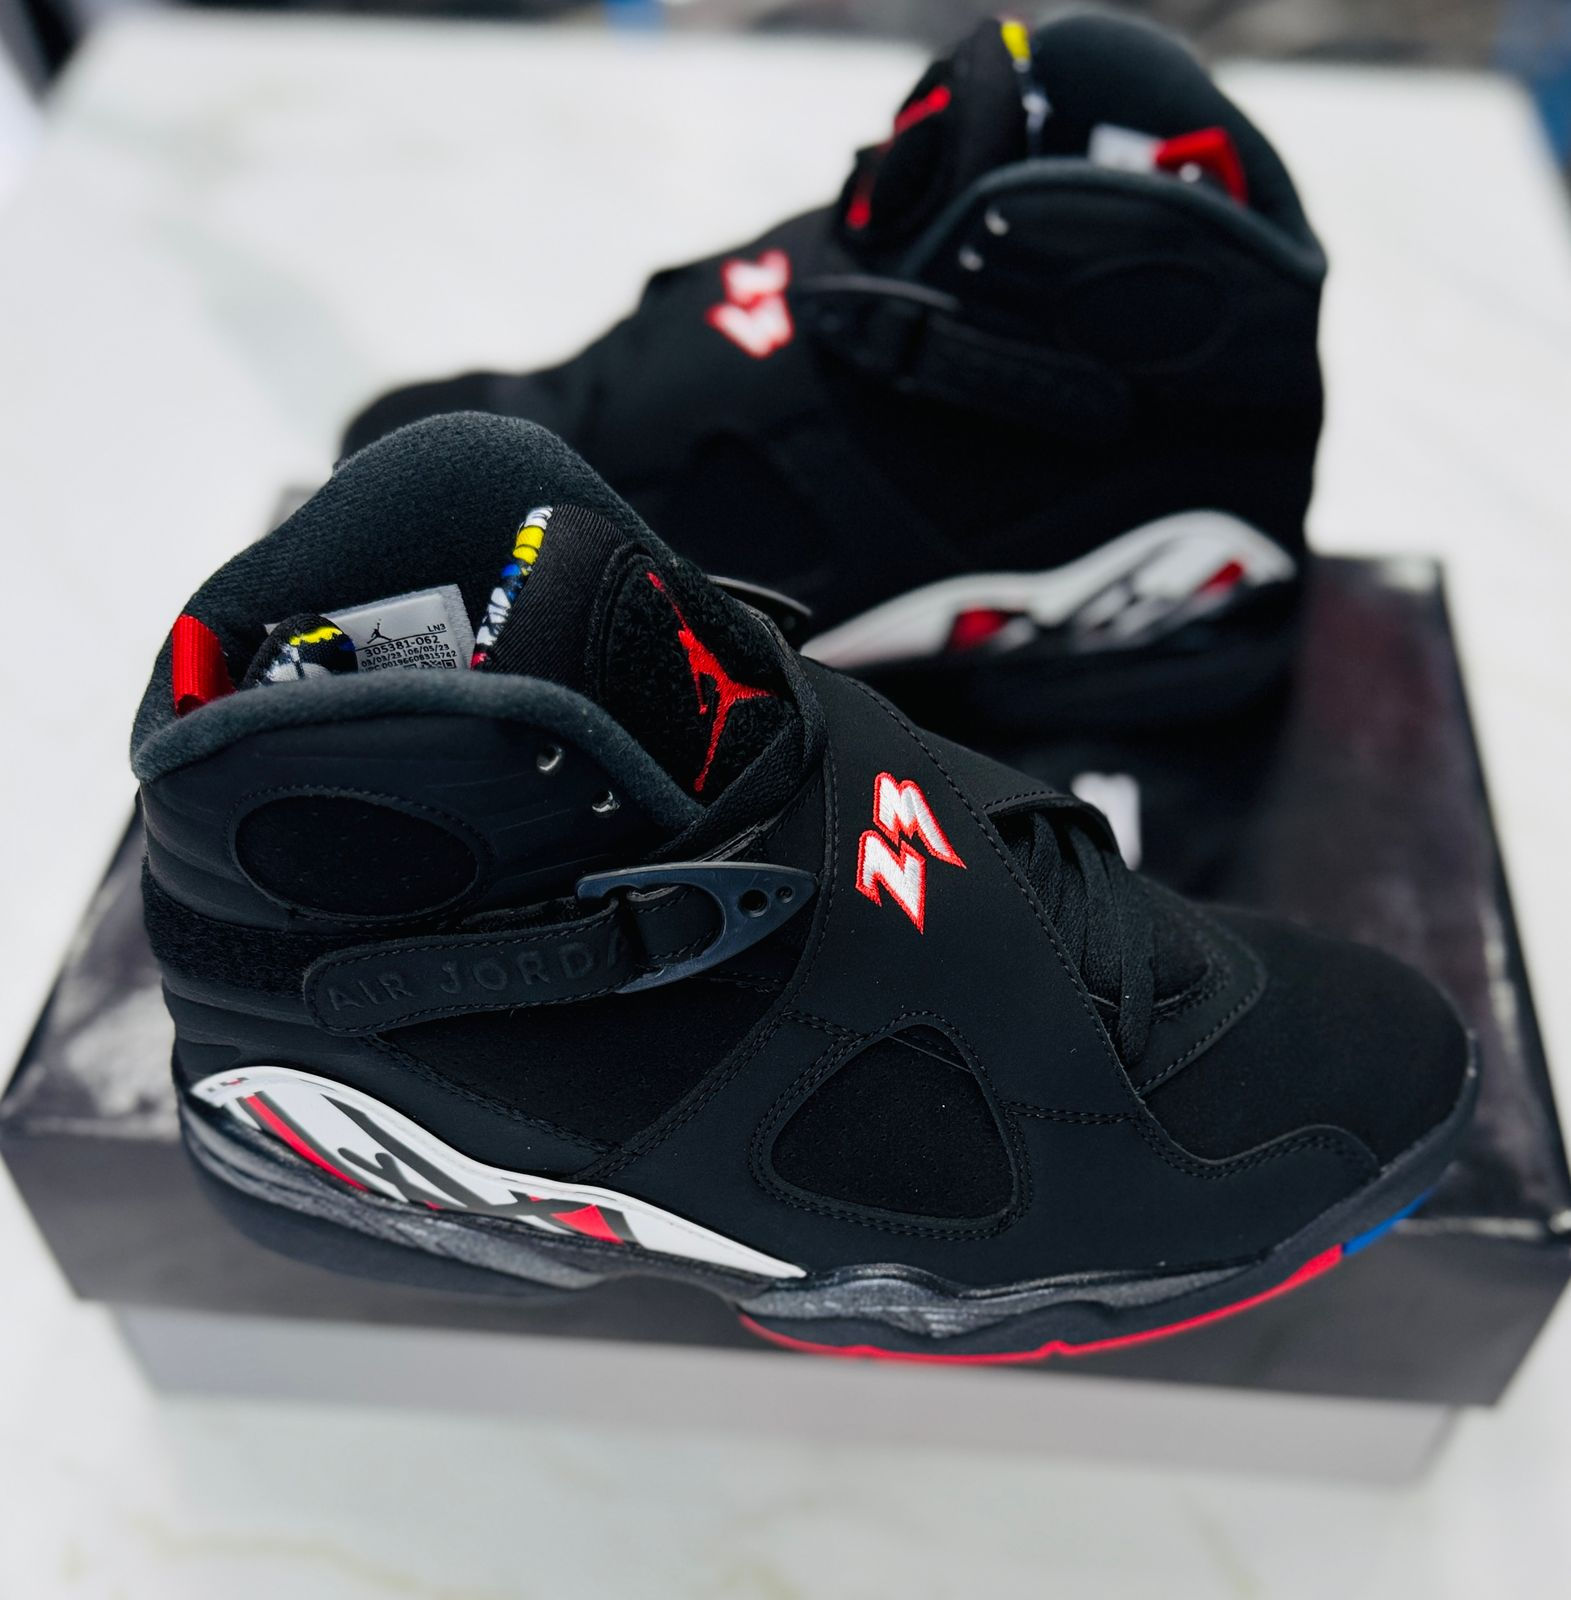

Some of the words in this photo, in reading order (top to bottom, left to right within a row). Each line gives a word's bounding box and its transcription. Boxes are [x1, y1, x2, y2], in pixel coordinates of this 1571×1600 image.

[427, 623, 446, 633] LN3
[364, 635, 441, 657] 305381-062
[361, 651, 402, 668] 03/03/23
[855, 771, 967, 935] 23
[328, 971, 414, 1012] AIR
